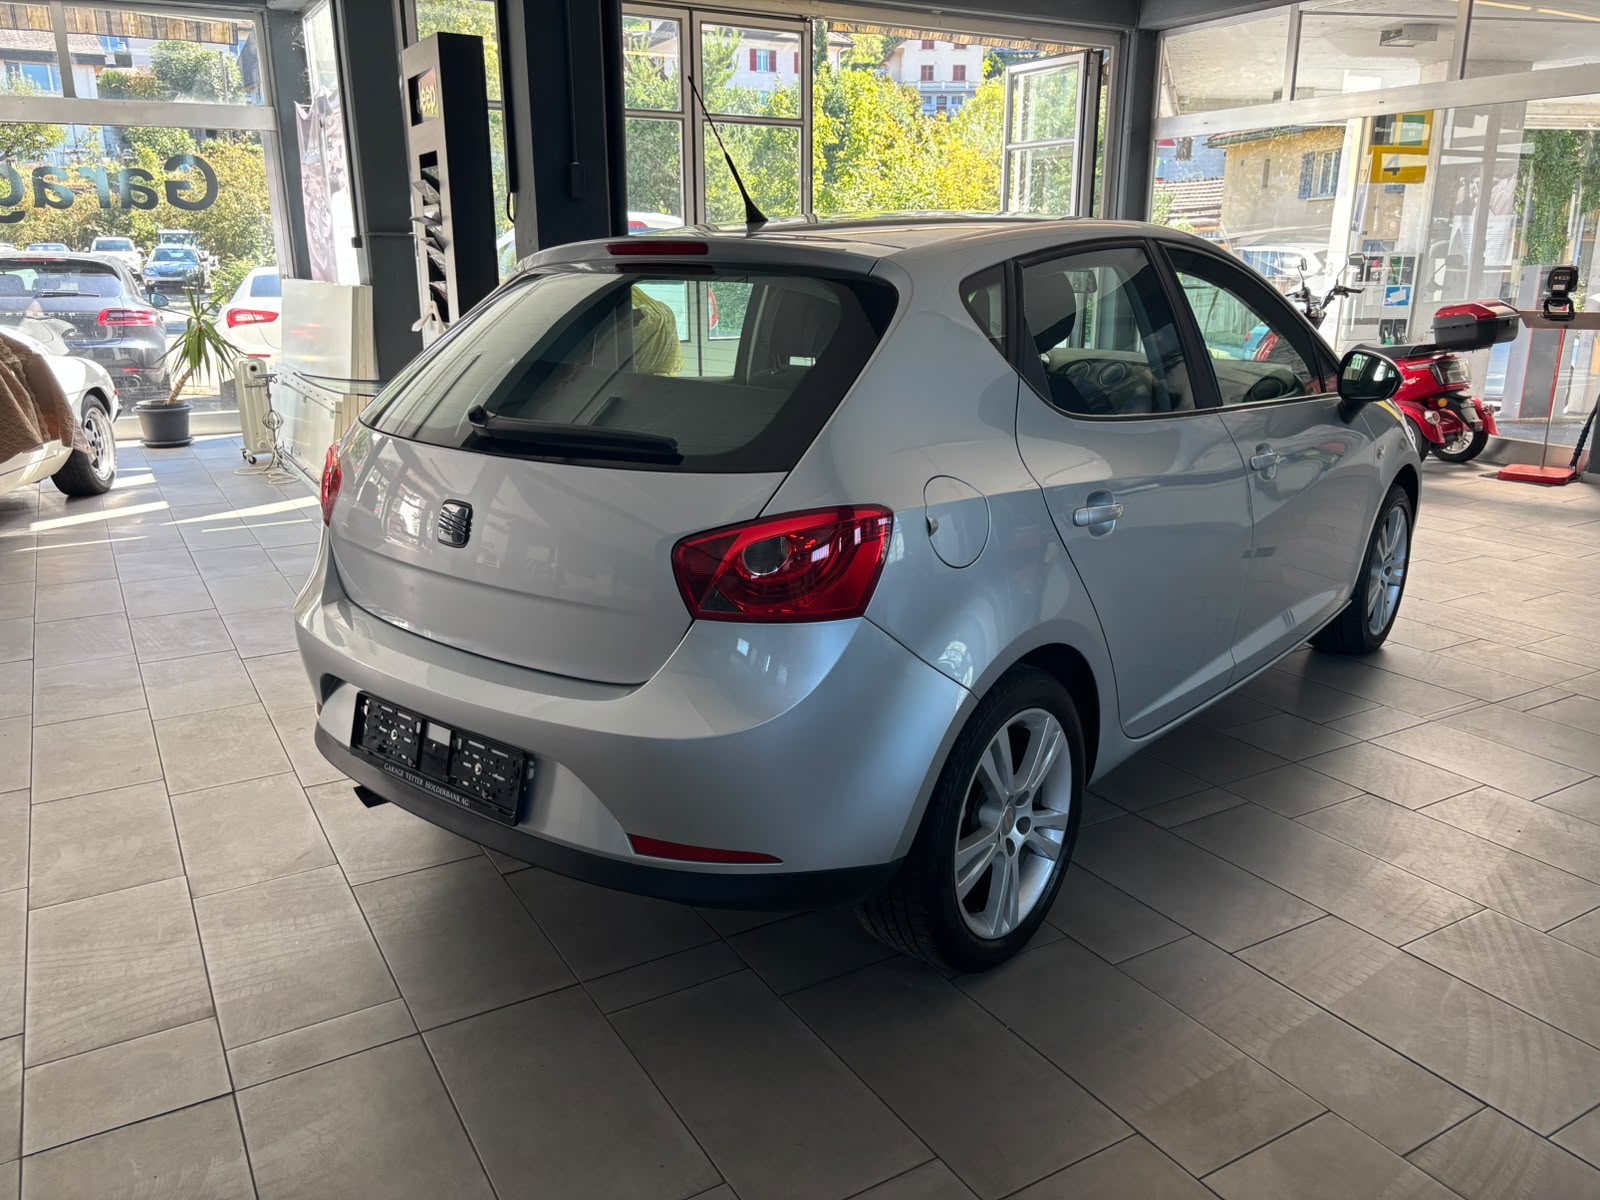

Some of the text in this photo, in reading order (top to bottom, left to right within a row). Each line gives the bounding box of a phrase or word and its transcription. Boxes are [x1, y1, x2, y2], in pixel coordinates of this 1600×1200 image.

[1383, 154, 1400, 176] 4
[383, 762, 470, 807] GARAGE VETTER HOLDERBANK AG
